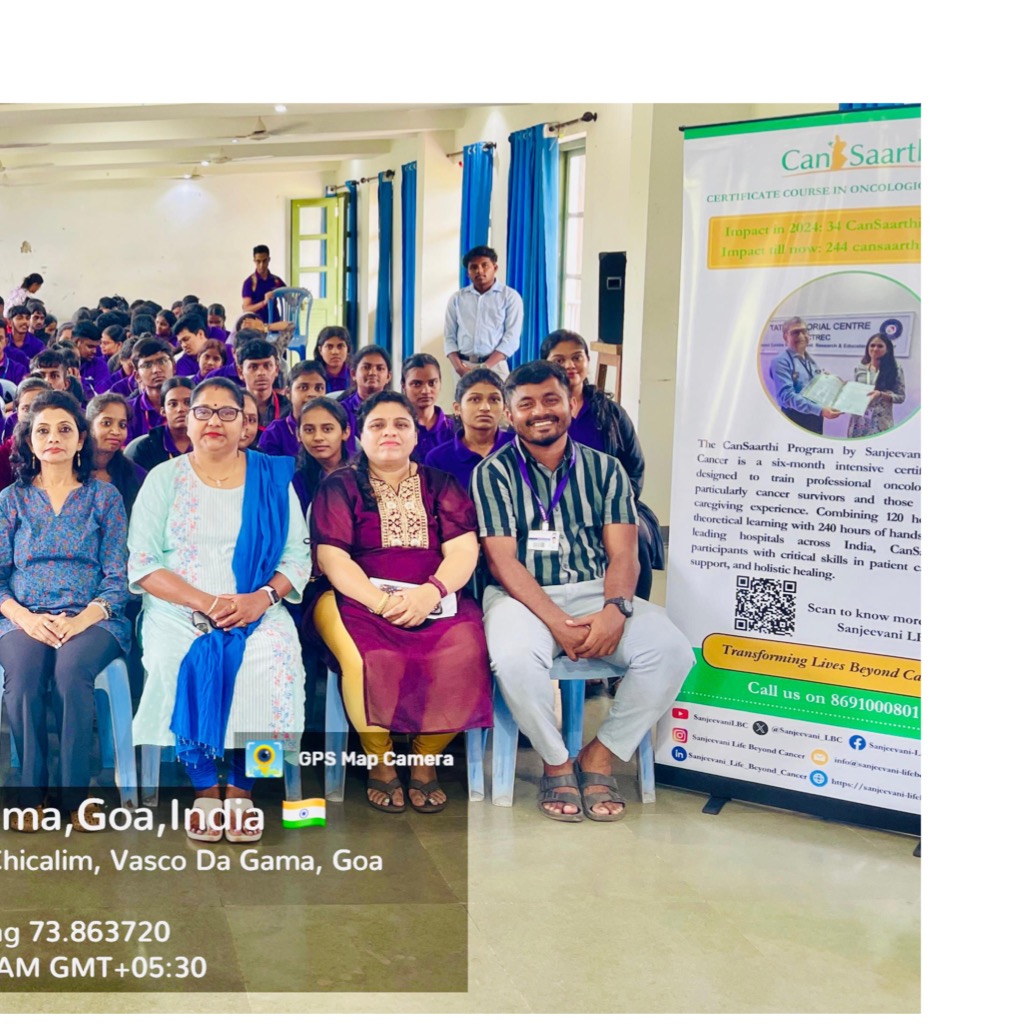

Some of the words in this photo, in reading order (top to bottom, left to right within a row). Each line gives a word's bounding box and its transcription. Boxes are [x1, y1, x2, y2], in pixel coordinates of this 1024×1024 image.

[781, 149, 830, 171] Can
[707, 189, 780, 203] CERTIFICATE
[783, 186, 829, 199] COURSE
[725, 225, 769, 240] Impact
[722, 246, 765, 260] Impact
[826, 241, 848, 253] 244
[697, 439, 716, 449] The
[723, 440, 779, 452] CanSaarthi
[787, 443, 834, 456] Program
[843, 446, 856, 458] by
[865, 447, 921, 460] Sanjeevan
[697, 453, 728, 465] Cancer
[771, 458, 825, 470] six-month
[835, 461, 884, 473] intensive
[696, 469, 738, 482] designed
[771, 473, 795, 483] train
[806, 476, 871, 488] professional
[695, 485, 748, 498] particularly
[756, 489, 791, 499] cancer
[797, 491, 845, 502] survivors
[854, 494, 875, 504] and
[883, 496, 914, 507] those
[694, 500, 743, 513] caregiving
[750, 503, 809, 515] experience.
[816, 506, 879, 524] Combining
[886, 512, 904, 522] 120
[693, 513, 743, 526] theoretical
[746, 516, 788, 531] learning
[792, 520, 815, 531] with
[818, 522, 837, 533] 240
[840, 524, 871, 536] hours
[874, 527, 888, 537] of
[692, 527, 727, 541] leading
[739, 530, 785, 545] hospitals
[797, 538, 831, 548] across
[844, 539, 877, 554] India,
[691, 543, 749, 556] participants
[753, 547, 776, 558] with
[780, 550, 816, 562] critical
[821, 553, 848, 565] skills
[869, 559, 908, 571] patient
[690, 558, 730, 570] support,
[732, 561, 752, 571] and
[754, 562, 791, 575] holistic
[793, 565, 835, 581] healing.
[807, 602, 836, 615] Scan
[840, 608, 852, 617] to
[856, 608, 890, 622] know
[837, 622, 903, 640] Sanjeevani
[722, 644, 808, 669] Transforming
[811, 656, 846, 671] Lives
[849, 661, 900, 680] Beyond
[747, 681, 778, 697] Call
[782, 689, 801, 701] us
[805, 692, 826, 704] on
[830, 693, 920, 719] 8691000801
[693, 713, 749, 729] SanjeevaniLBC
[692, 733, 730, 747] Sanjeevani
[748, 743, 777, 755] Beyond
[778, 749, 806, 760] Cancer
